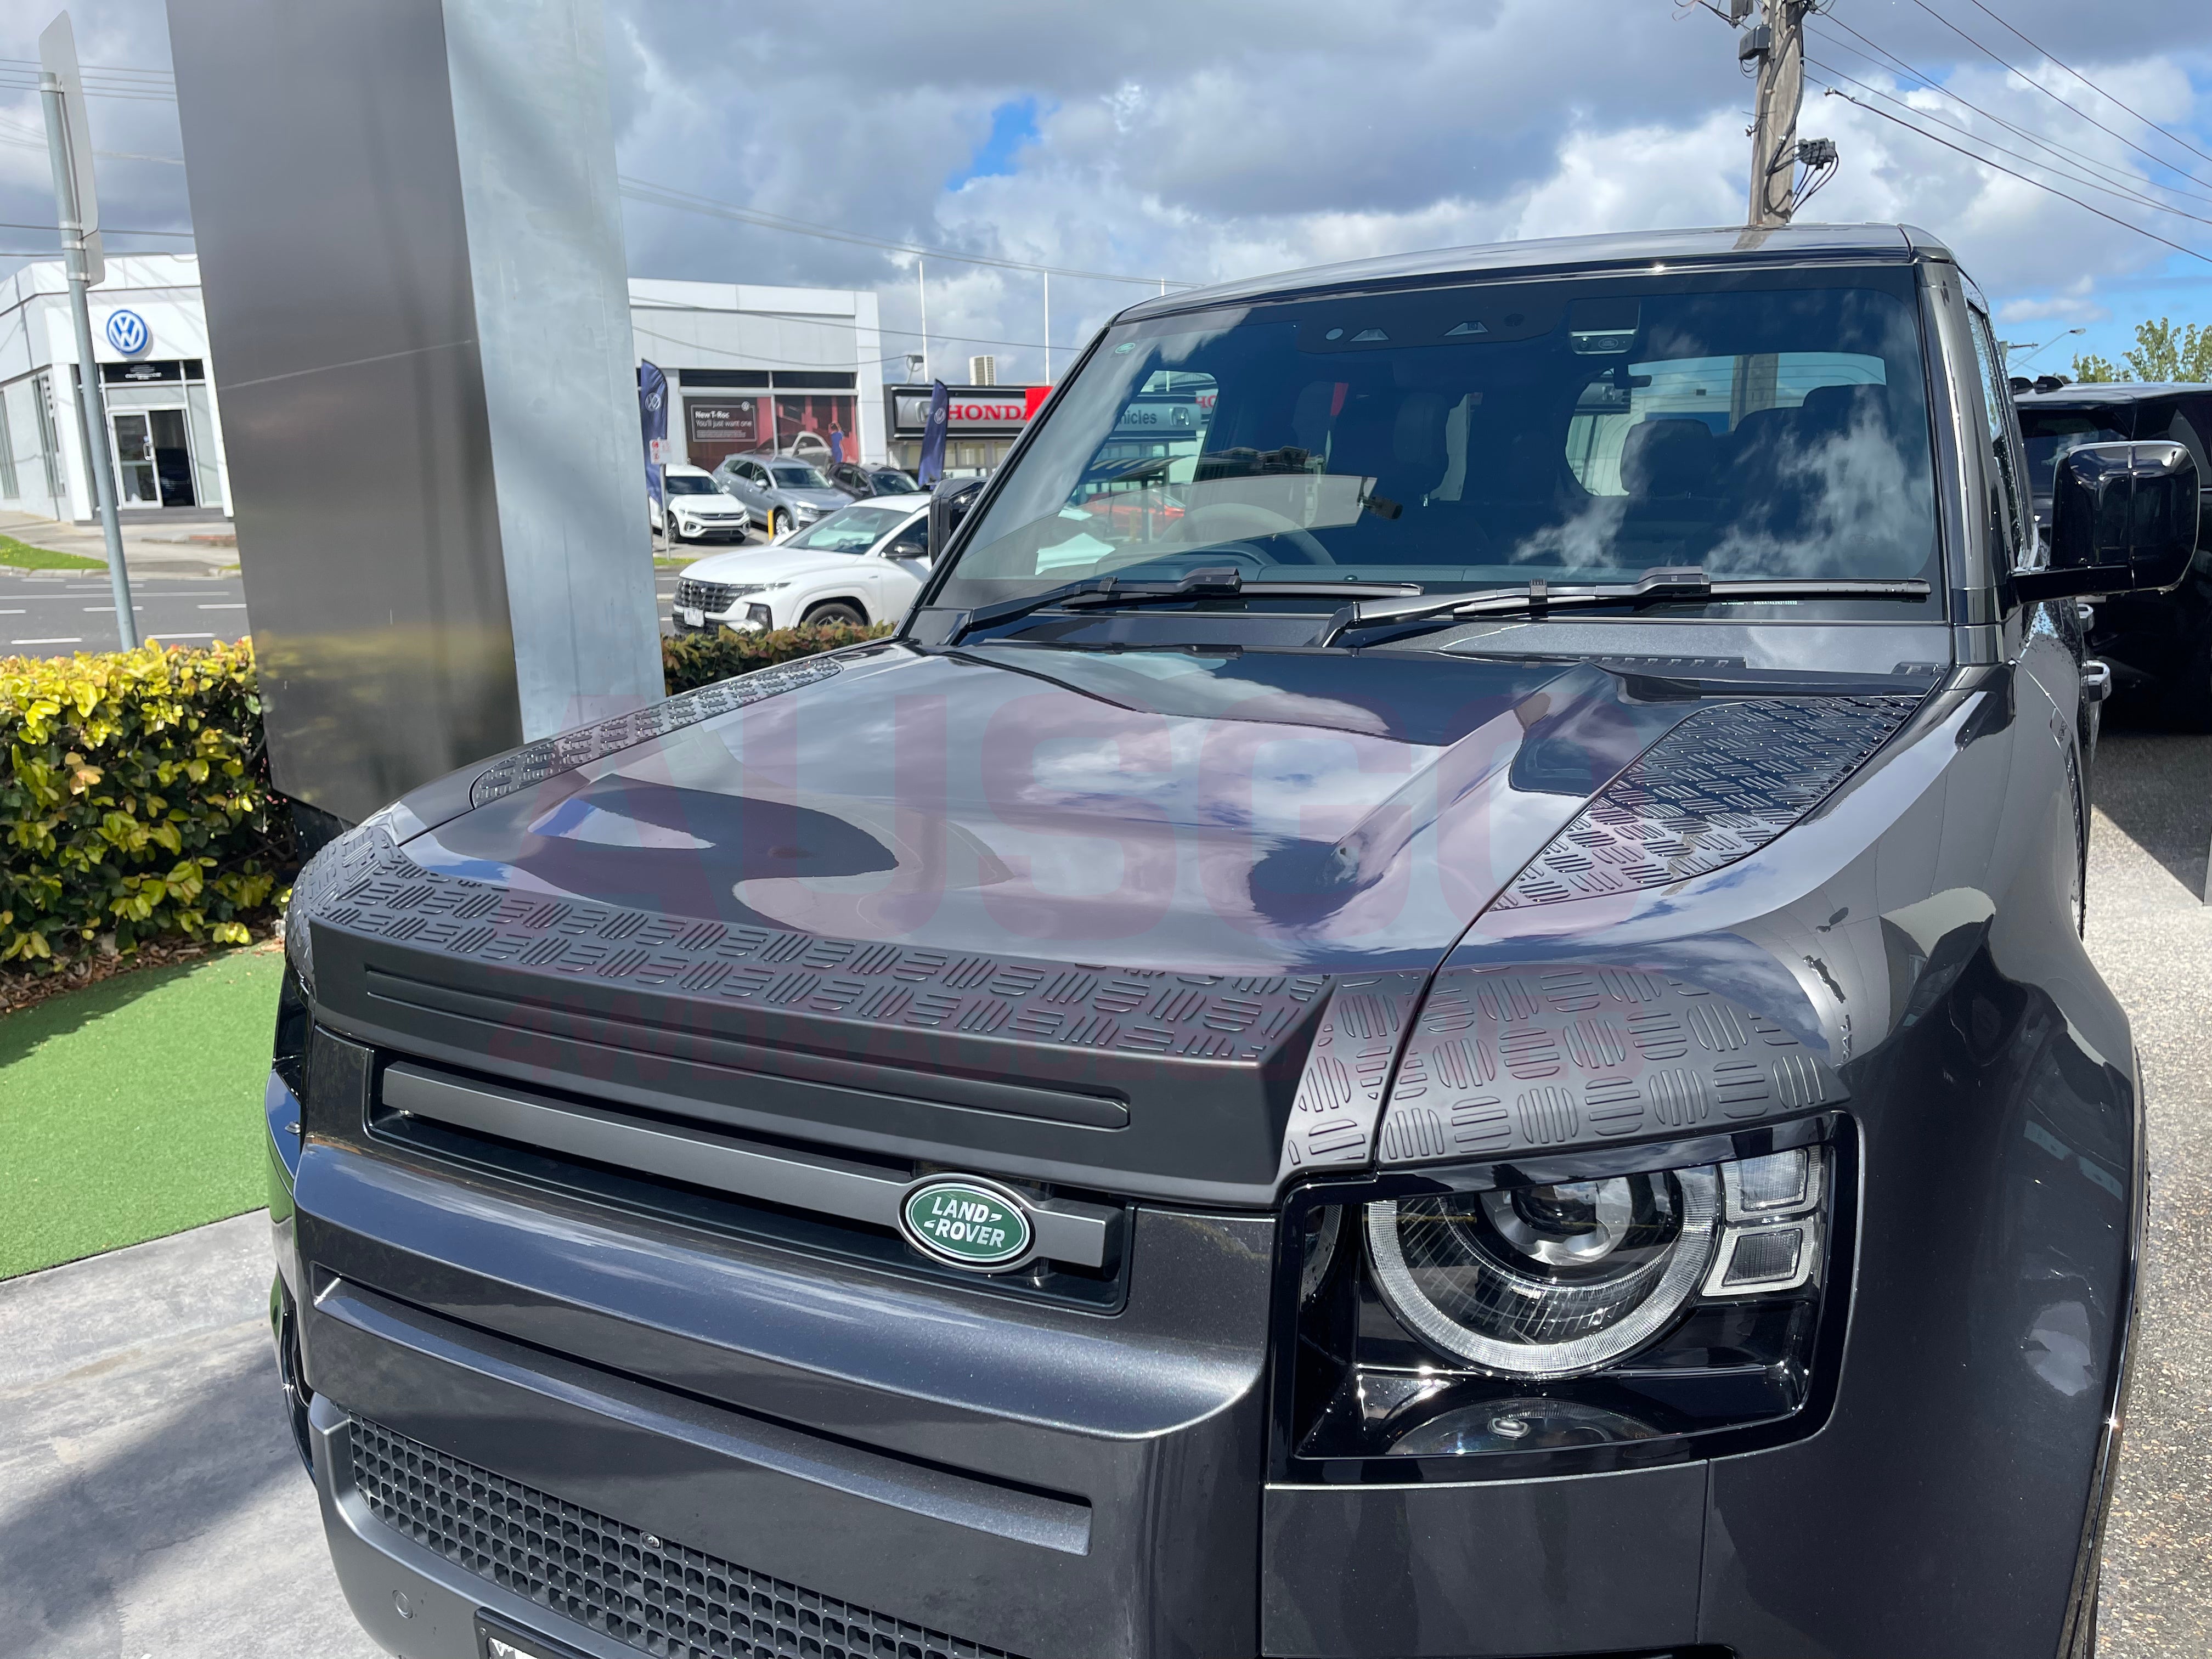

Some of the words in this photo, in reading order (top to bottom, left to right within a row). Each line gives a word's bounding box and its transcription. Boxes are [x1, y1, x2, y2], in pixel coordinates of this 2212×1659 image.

[712, 420, 724, 428] just
[932, 1197, 989, 1223] LAND
[935, 1218, 1005, 1248] ROVER
